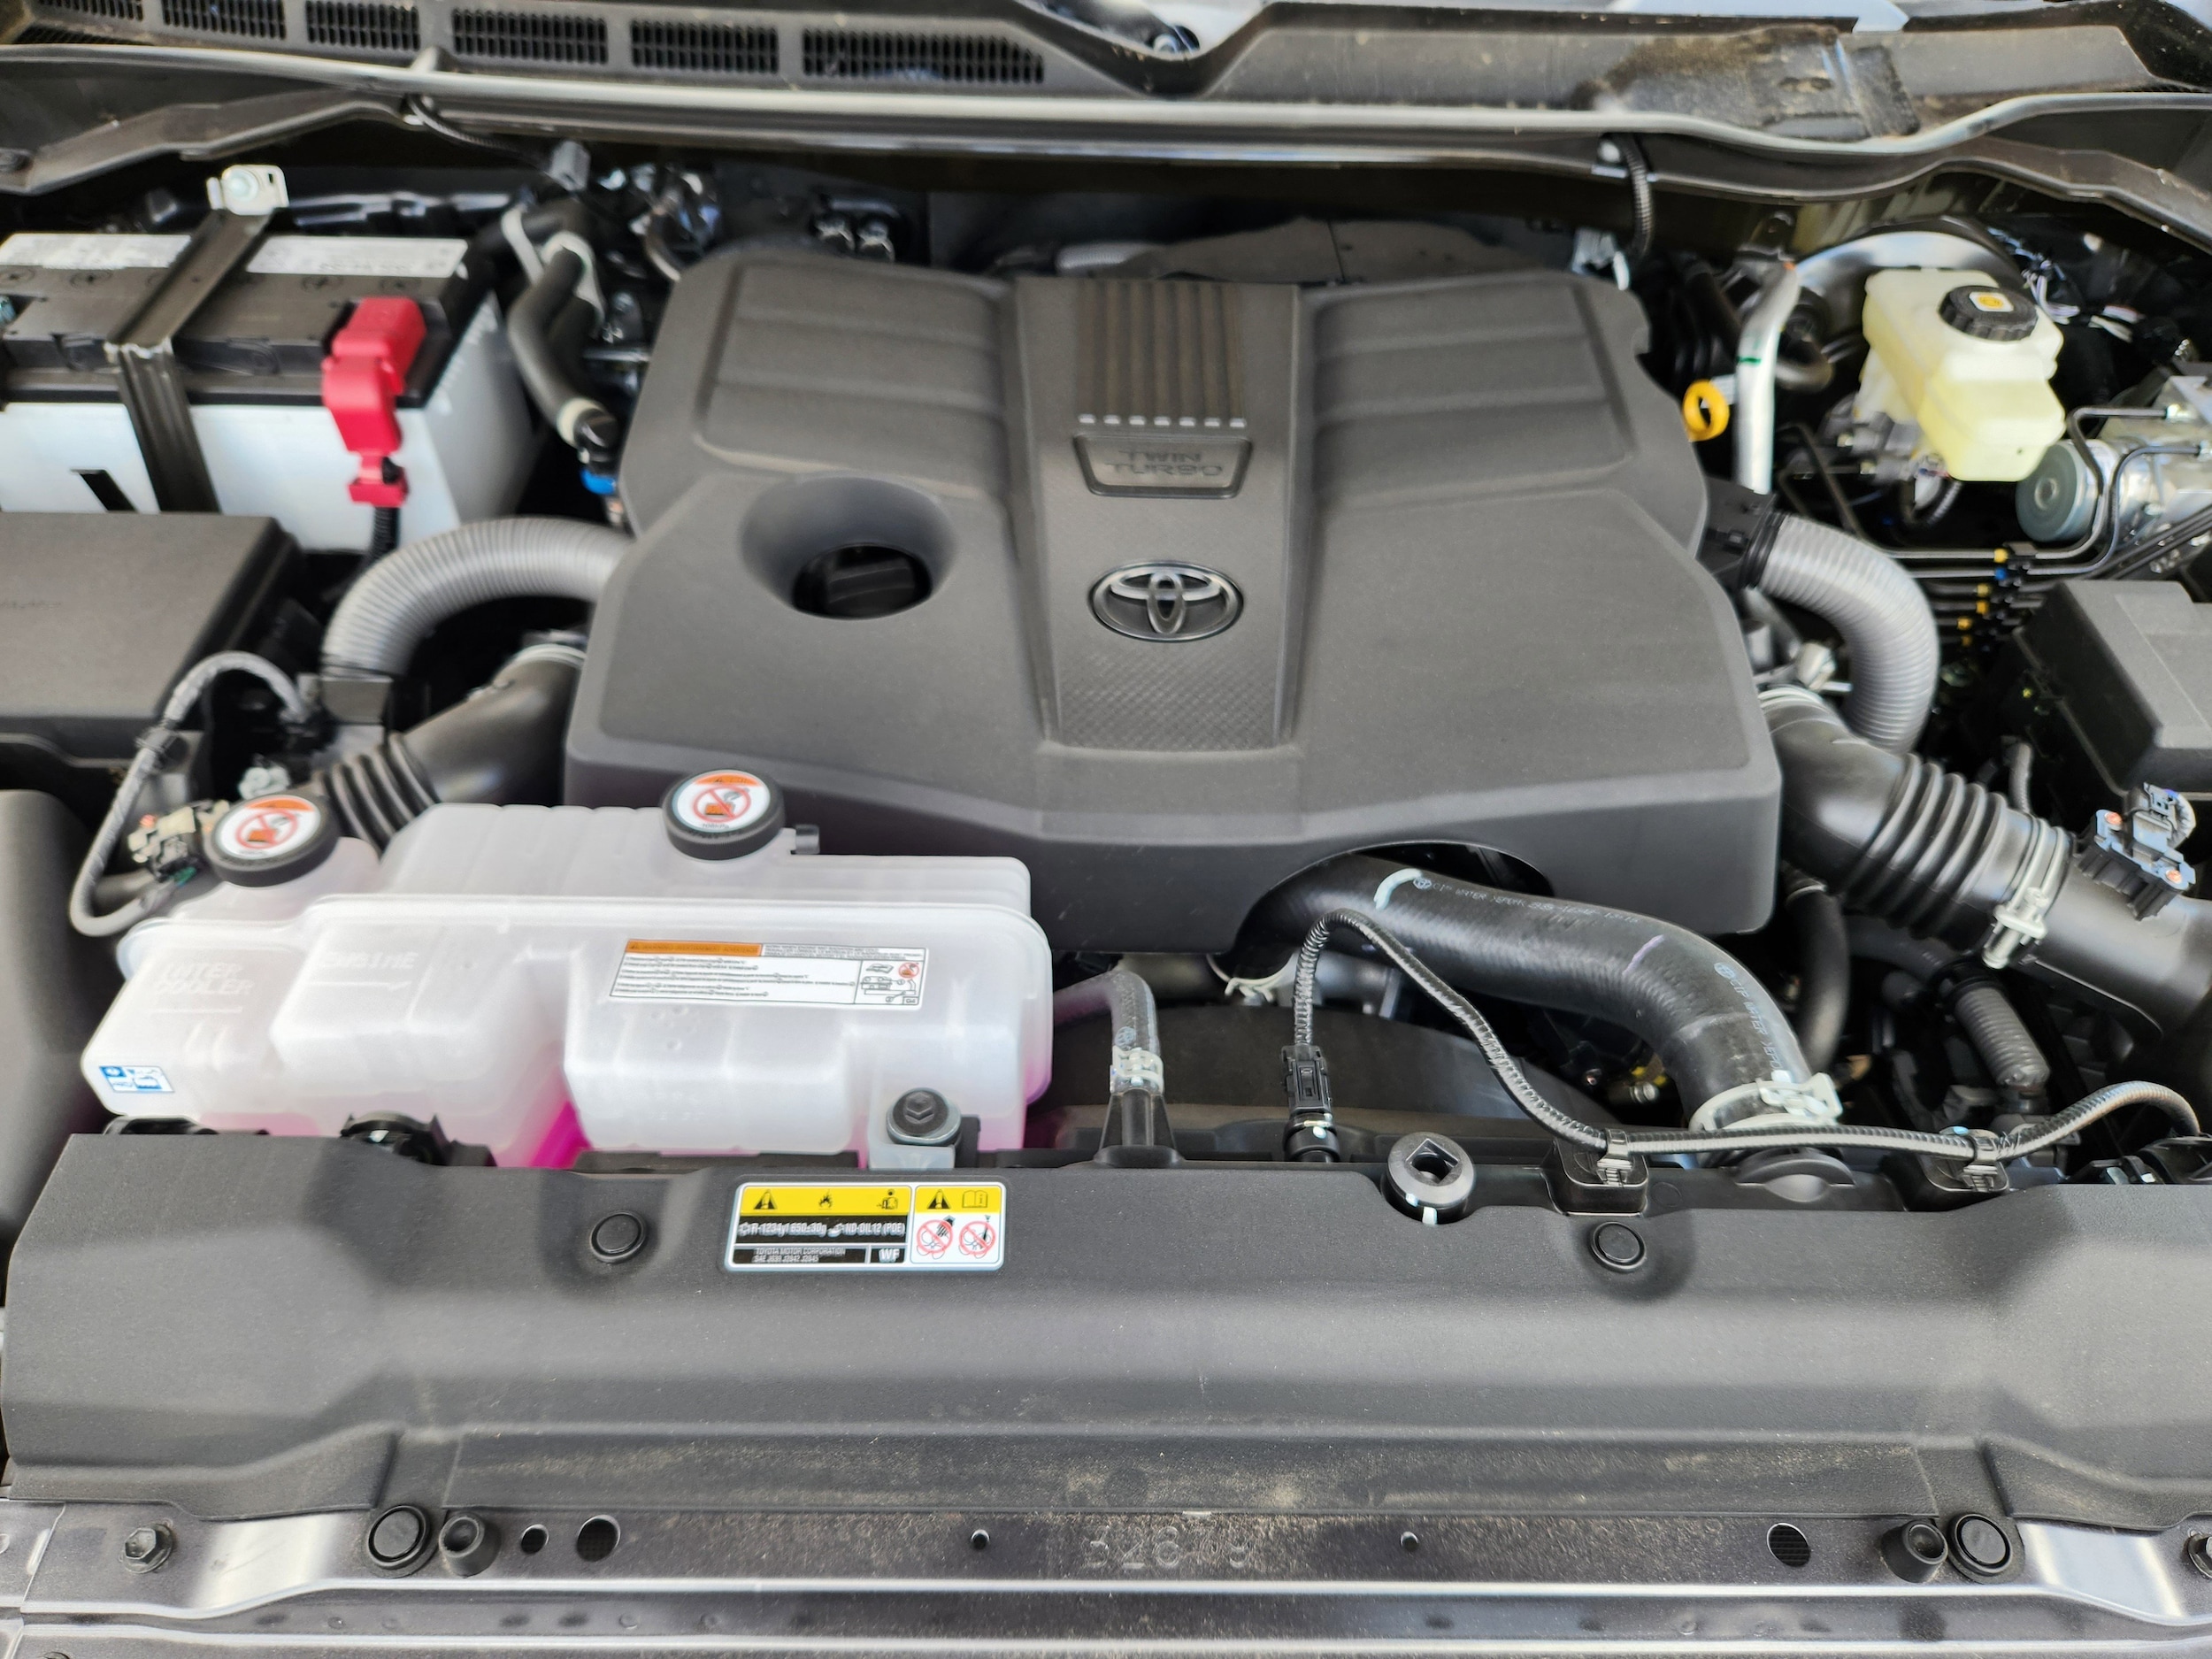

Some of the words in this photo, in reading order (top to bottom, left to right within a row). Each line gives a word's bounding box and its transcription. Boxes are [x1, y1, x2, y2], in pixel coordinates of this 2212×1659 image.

[1118, 449, 1202, 464] TWIN
[1103, 463, 1223, 477] TURBO
[320, 950, 419, 970] ENGINE
[164, 961, 244, 980] INTER
[754, 1247, 780, 1256] TOYOTA
[780, 1247, 803, 1256] MOTOR
[803, 1247, 847, 1256] CORPORATION
[879, 1248, 900, 1263] WF
